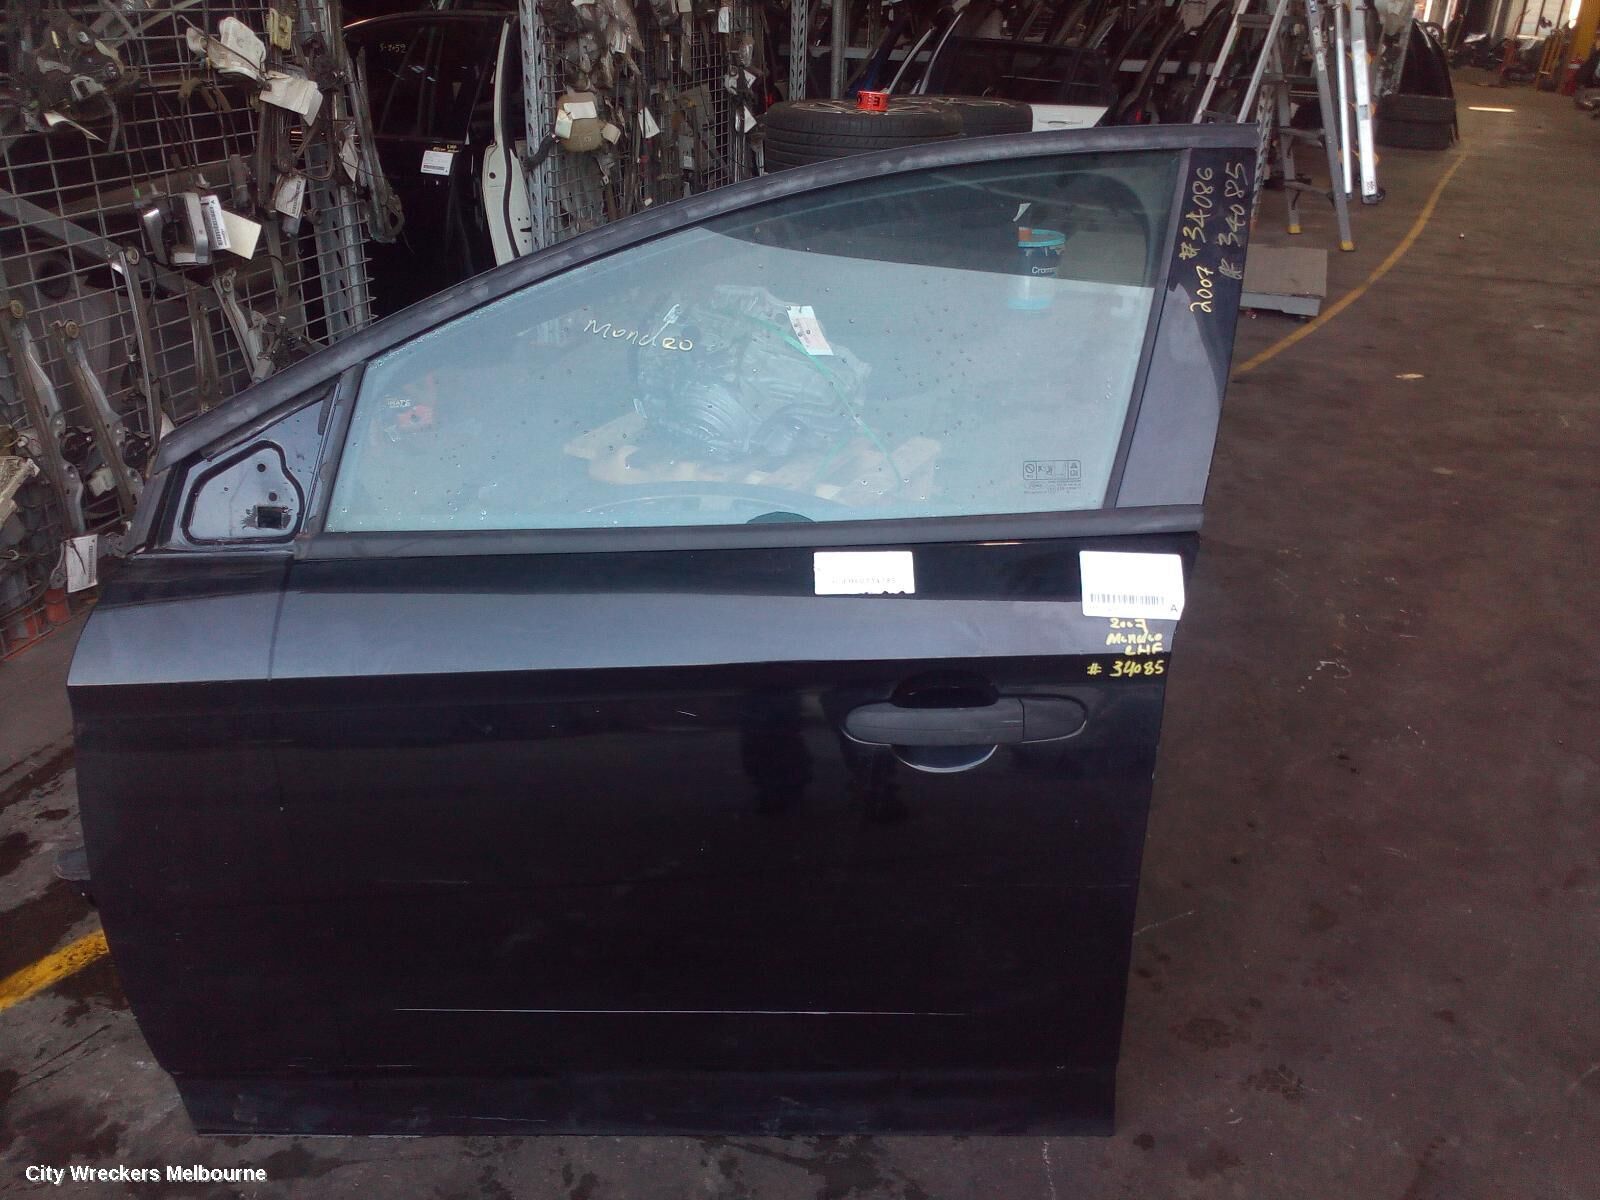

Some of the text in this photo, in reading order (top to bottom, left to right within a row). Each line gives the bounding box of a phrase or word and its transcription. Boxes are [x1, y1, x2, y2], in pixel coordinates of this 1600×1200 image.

[1190, 265, 1214, 313] 2007
[583, 303, 693, 351] Mondeo
[1086, 659, 1165, 677] # 34085
